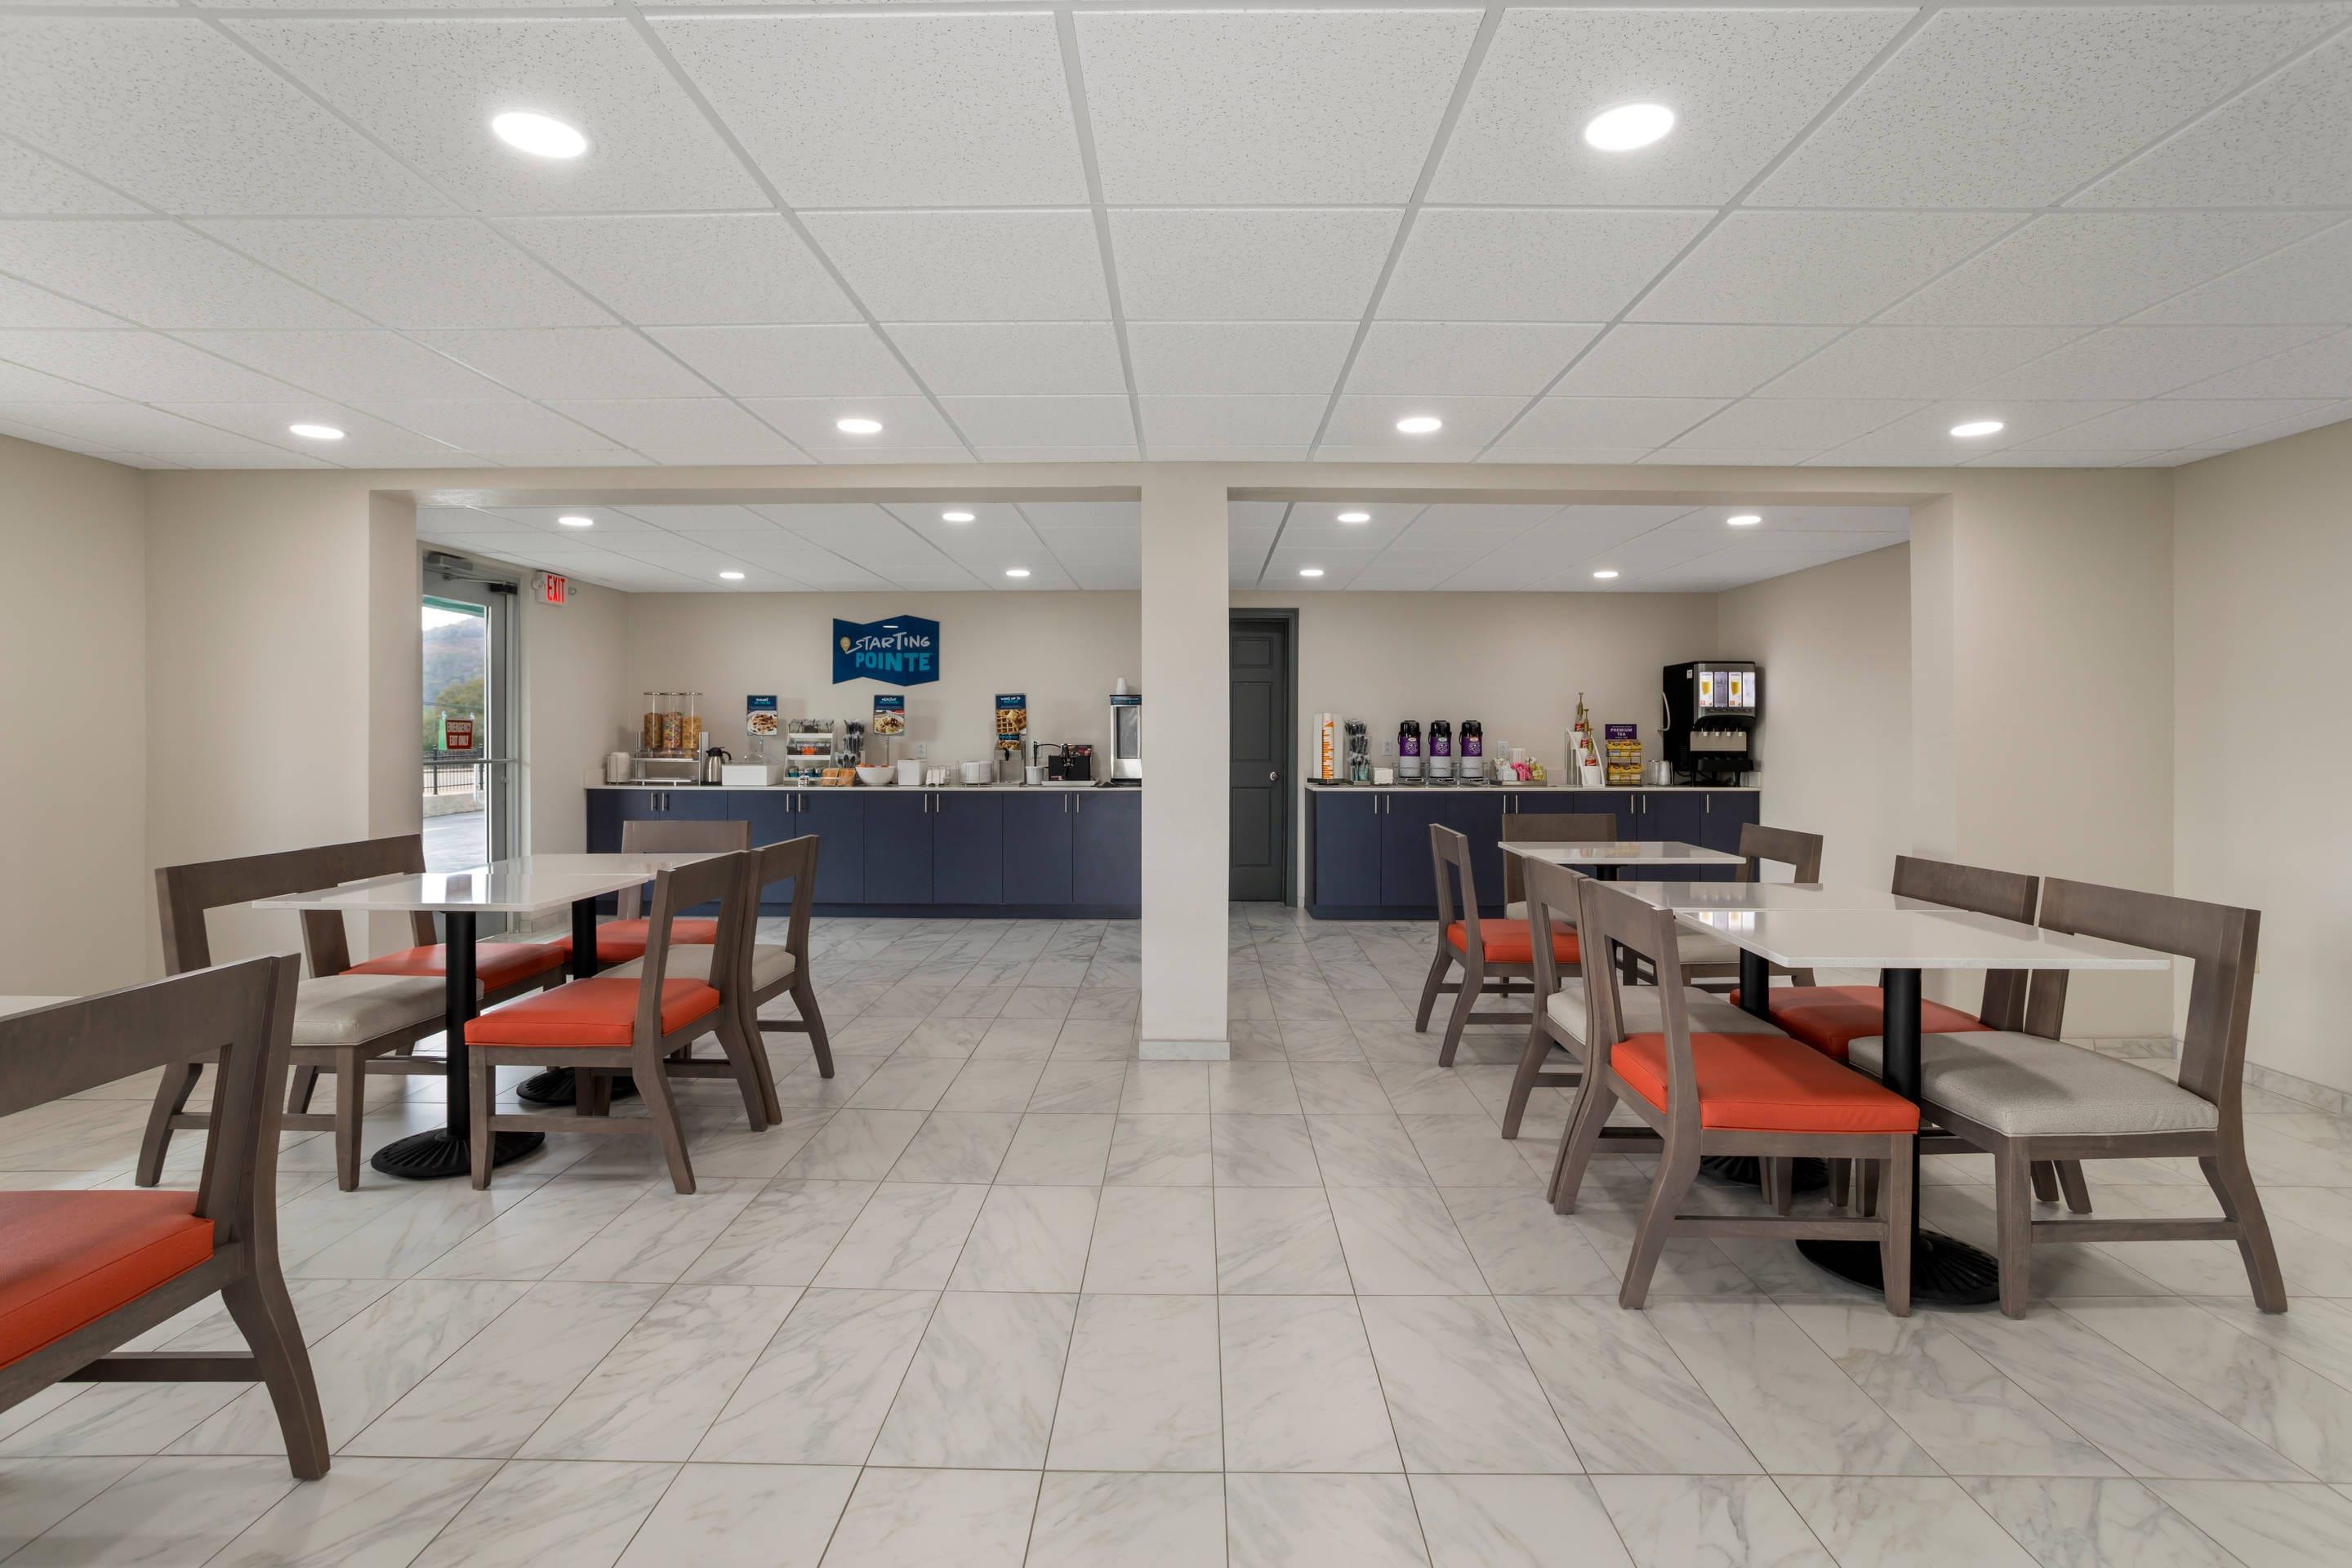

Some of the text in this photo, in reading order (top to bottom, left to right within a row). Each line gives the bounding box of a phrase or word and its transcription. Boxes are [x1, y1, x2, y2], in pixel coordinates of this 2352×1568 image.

[547, 574, 565, 603] EXIT
[845, 631, 931, 654] STARTING
[855, 652, 931, 672] POINTE
[447, 721, 472, 733] EMERGENCY
[449, 735, 469, 746] EXIT ONLY
